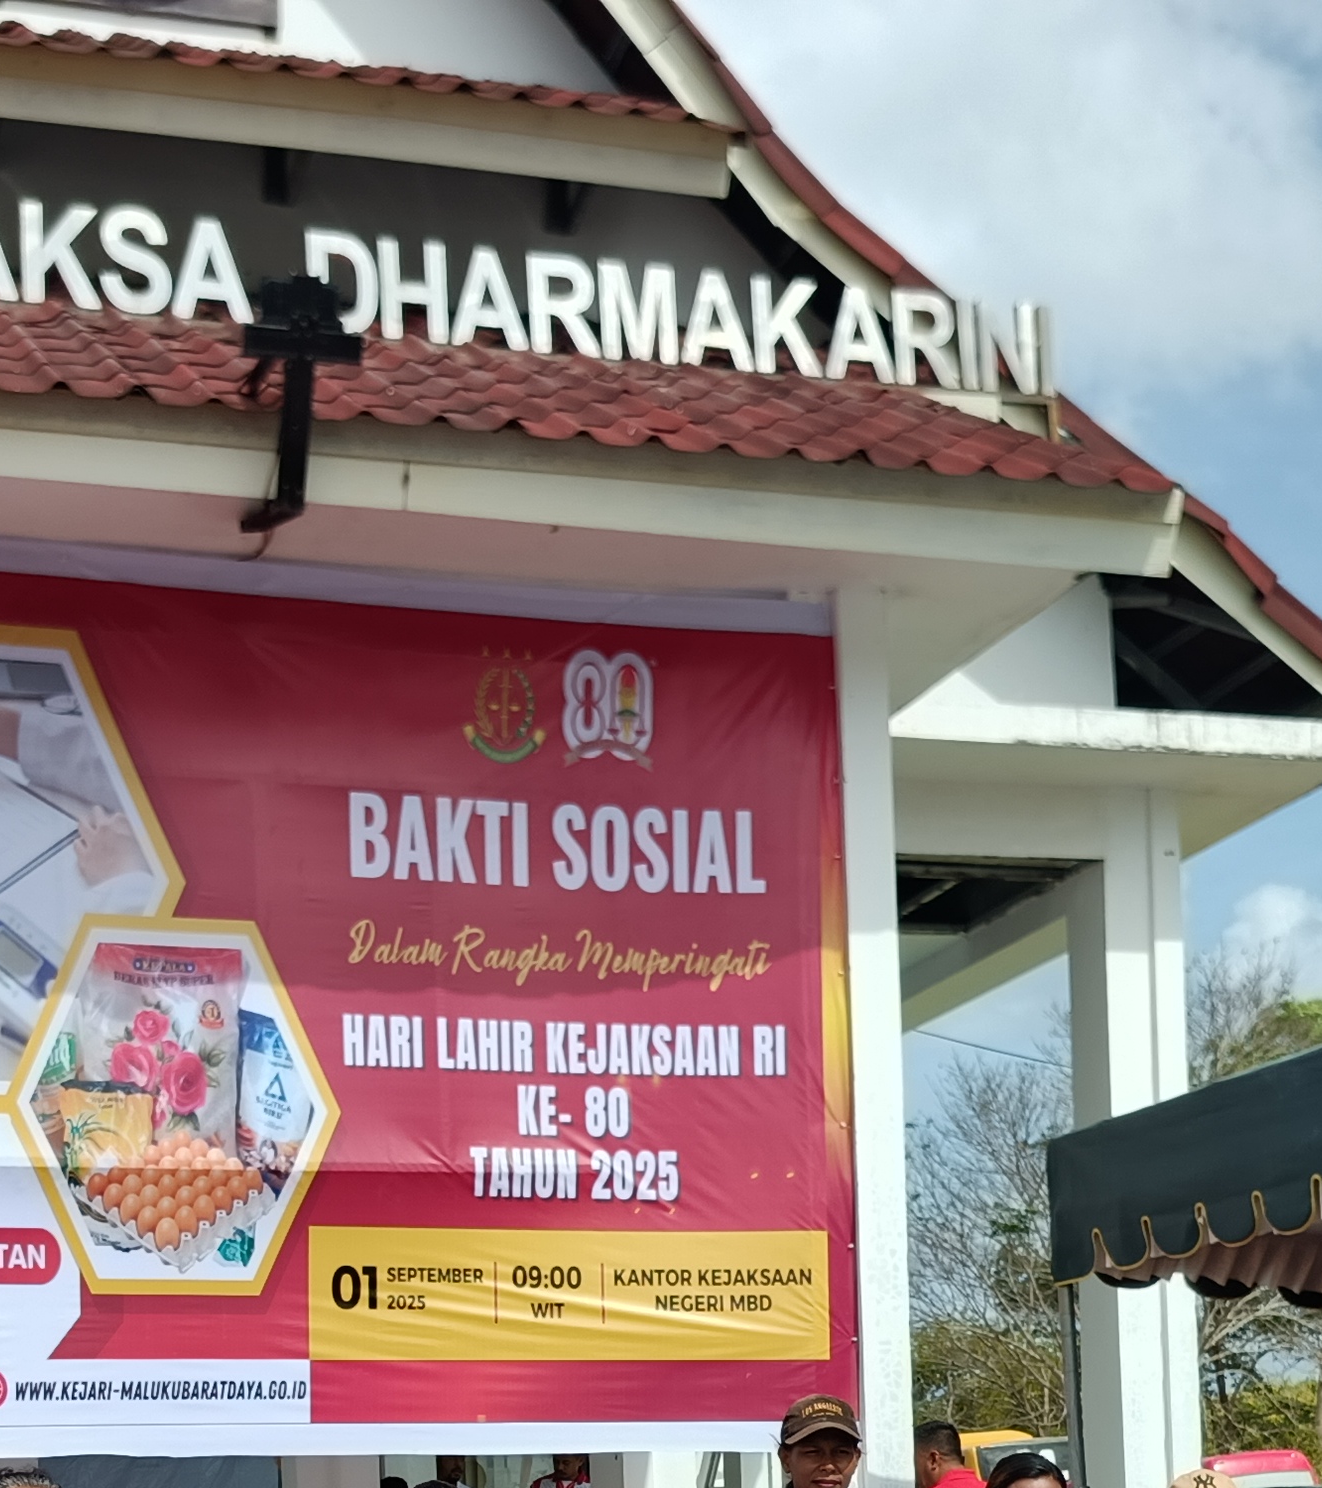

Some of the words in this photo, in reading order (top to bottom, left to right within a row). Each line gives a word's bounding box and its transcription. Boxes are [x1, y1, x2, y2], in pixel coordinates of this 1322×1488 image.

[304, 227, 1057, 398] DHARMAKARINI
[348, 791, 529, 887] BAKTI
[551, 803, 767, 894] SOSIAL
[348, 920, 447, 968] Dalam
[451, 927, 573, 987] Rangka
[576, 929, 772, 992] Memperingati
[341, 1013, 424, 1069] HARI
[437, 1017, 534, 1073] LAHIR
[546, 1021, 740, 1077] KEJAKSAAN
[753, 1025, 787, 1076] RI
[517, 1085, 573, 1136] KE-
[585, 1087, 630, 1138] 80
[470, 1146, 578, 1199] TAHUN
[591, 1150, 680, 1202] 2025
[331, 1265, 378, 1311] 01
[386, 1267, 484, 1284] SEPTEMBER
[511, 1265, 582, 1291] 09:00
[614, 1268, 692, 1287] KANTOR
[698, 1268, 813, 1287] KEJAKSAAN
[387, 1294, 426, 1311] 2025
[530, 1302, 565, 1320] WIT
[655, 1295, 724, 1312] NEGERI
[729, 1294, 772, 1312] MBD
[15, 1379, 307, 1402] WWW.KEJARI-MALUKUBARATDAYA.GO.ID
